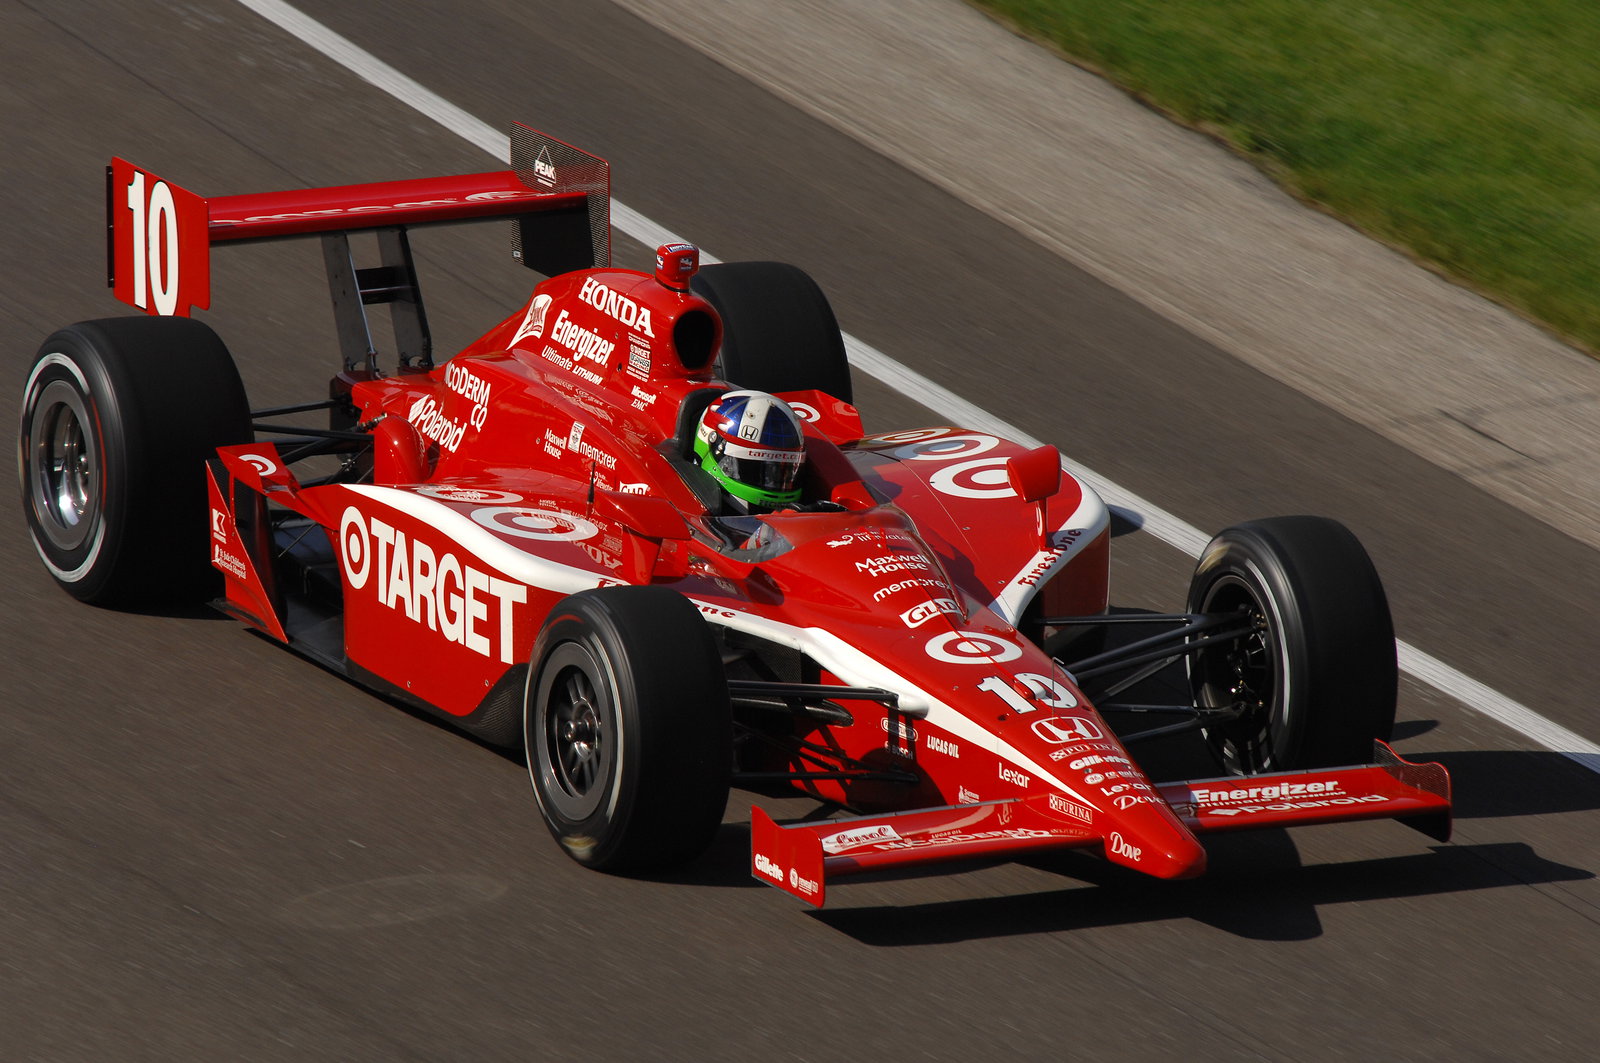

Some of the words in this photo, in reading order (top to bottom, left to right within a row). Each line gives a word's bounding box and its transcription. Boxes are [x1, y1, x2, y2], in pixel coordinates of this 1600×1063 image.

[535, 160, 555, 180] PEAK
[127, 170, 179, 316] 10
[578, 277, 655, 338] HONDA
[550, 309, 615, 365] Energizer
[541, 345, 573, 371] Ultimate
[573, 365, 603, 386] LITHIUM
[631, 385, 657, 405] Microsoft
[414, 399, 467, 453] Polaroid
[470, 403, 488, 433] CQ
[543, 441, 562, 460] House
[544, 428, 568, 450] Maxwell
[580, 441, 617, 470] memorex
[855, 553, 932, 573] Maxwell
[868, 562, 929, 577] House
[371, 516, 527, 665] TARGET
[907, 600, 960, 627] GLAD
[976, 672, 1078, 715] 10
[926, 734, 948, 754] LUCAS
[948, 742, 960, 759] OIL
[998, 762, 1030, 789] Lexar
[1113, 795, 1166, 811] Dove
[1192, 780, 1339, 803] Energizer
[1238, 794, 1390, 814] Polaroid
[1058, 798, 1092, 823] PURINA
[1109, 831, 1142, 862] Dove
[754, 853, 784, 882] Gillette
